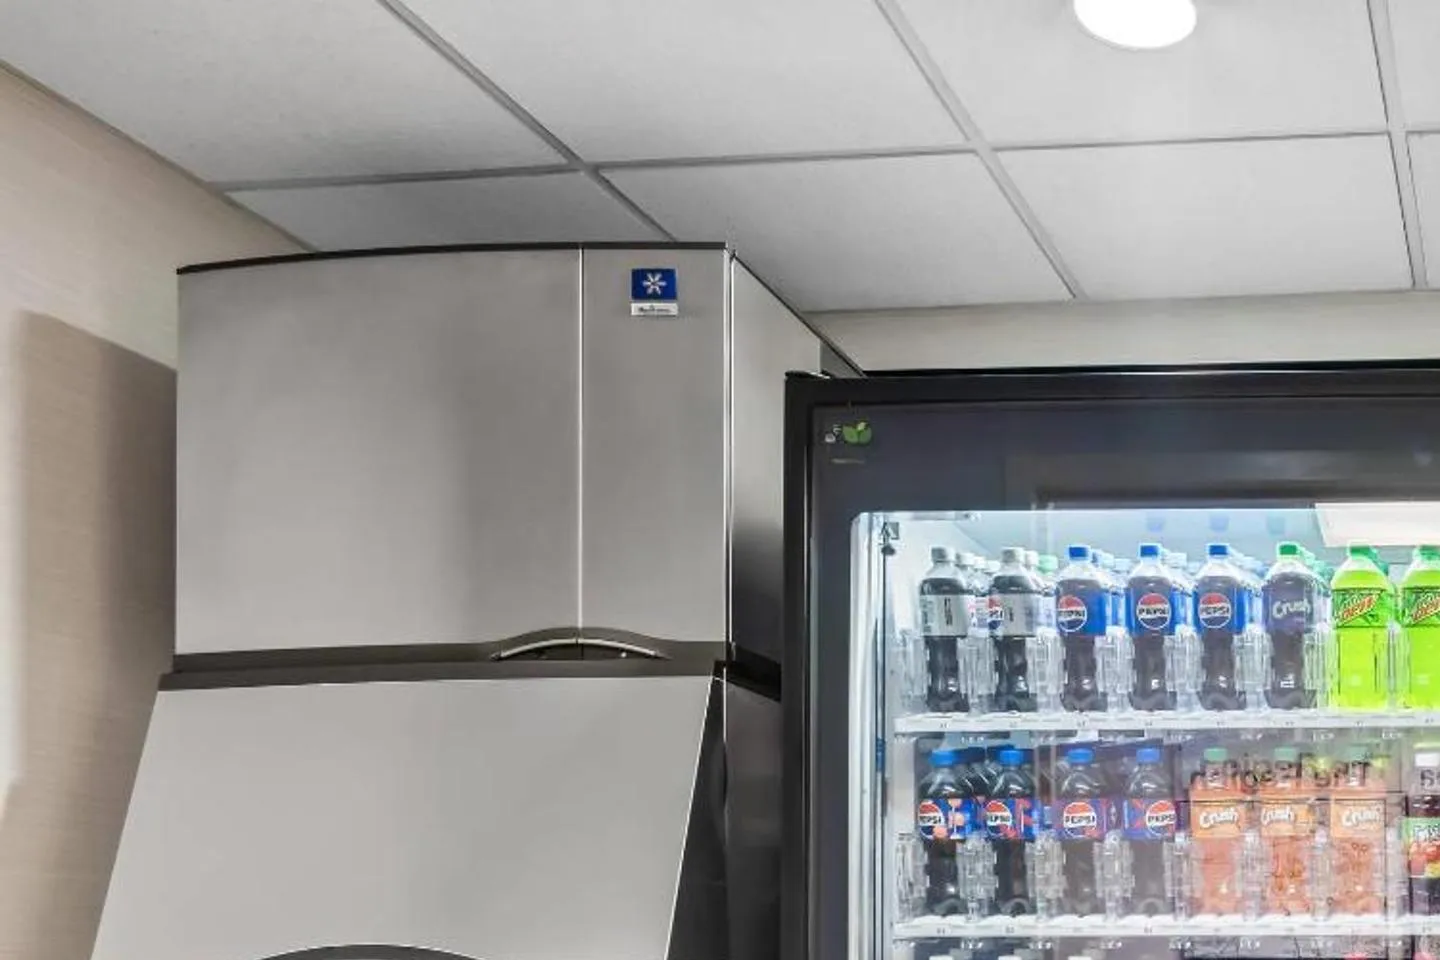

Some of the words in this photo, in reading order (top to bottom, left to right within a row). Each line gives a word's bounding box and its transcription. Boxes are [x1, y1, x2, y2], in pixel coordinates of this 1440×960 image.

[1272, 602, 1311, 620] Crush
[1065, 815, 1097, 826] PEPSI
[1200, 808, 1238, 828] Crush
[1341, 808, 1381, 828] Crush
